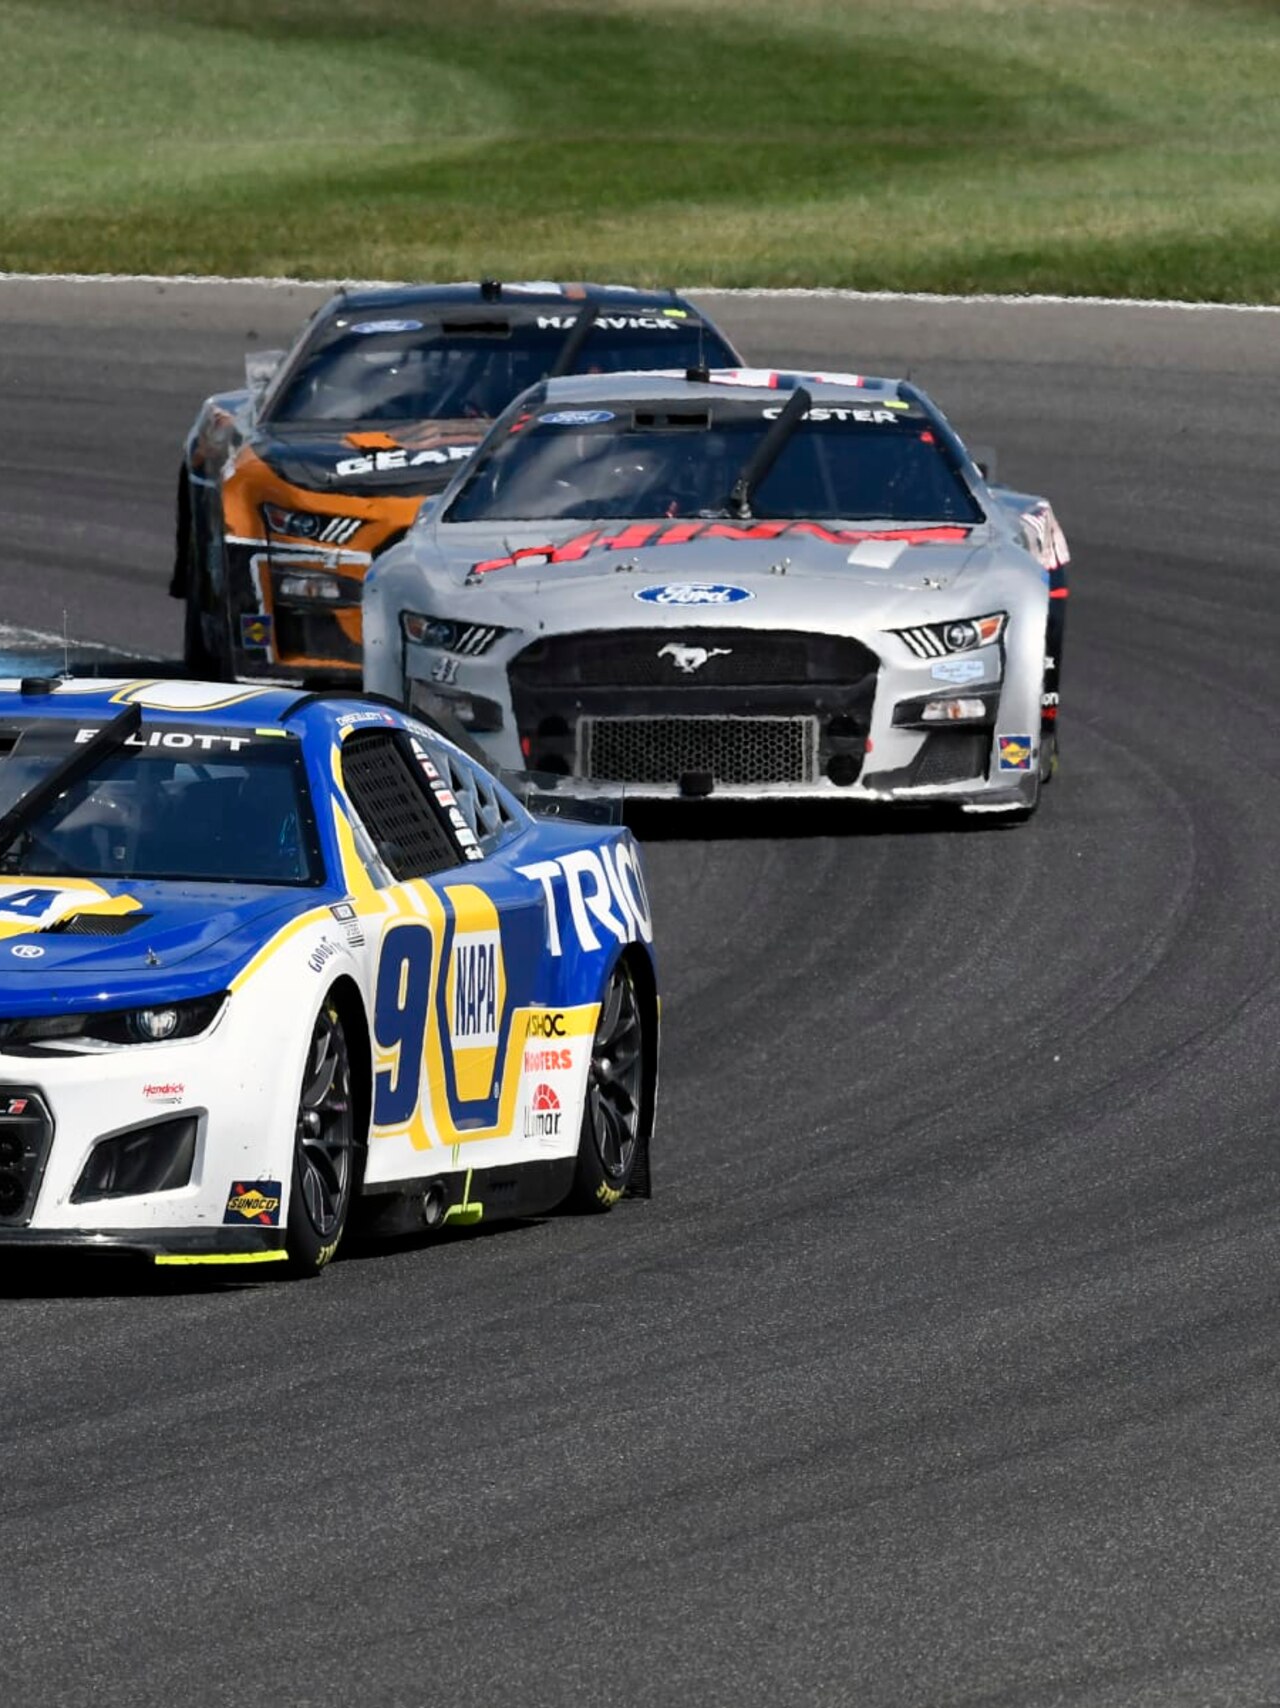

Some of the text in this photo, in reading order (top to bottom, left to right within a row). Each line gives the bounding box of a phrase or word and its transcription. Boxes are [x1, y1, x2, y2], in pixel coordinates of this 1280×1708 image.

[762, 408, 899, 424] CSTER
[74, 729, 251, 751] ELIOTT
[455, 943, 496, 1036] NAPA
[373, 922, 434, 1126] 9
[142, 1083, 185, 1098] Hendrick
[230, 1197, 276, 1210] SUNOCO
